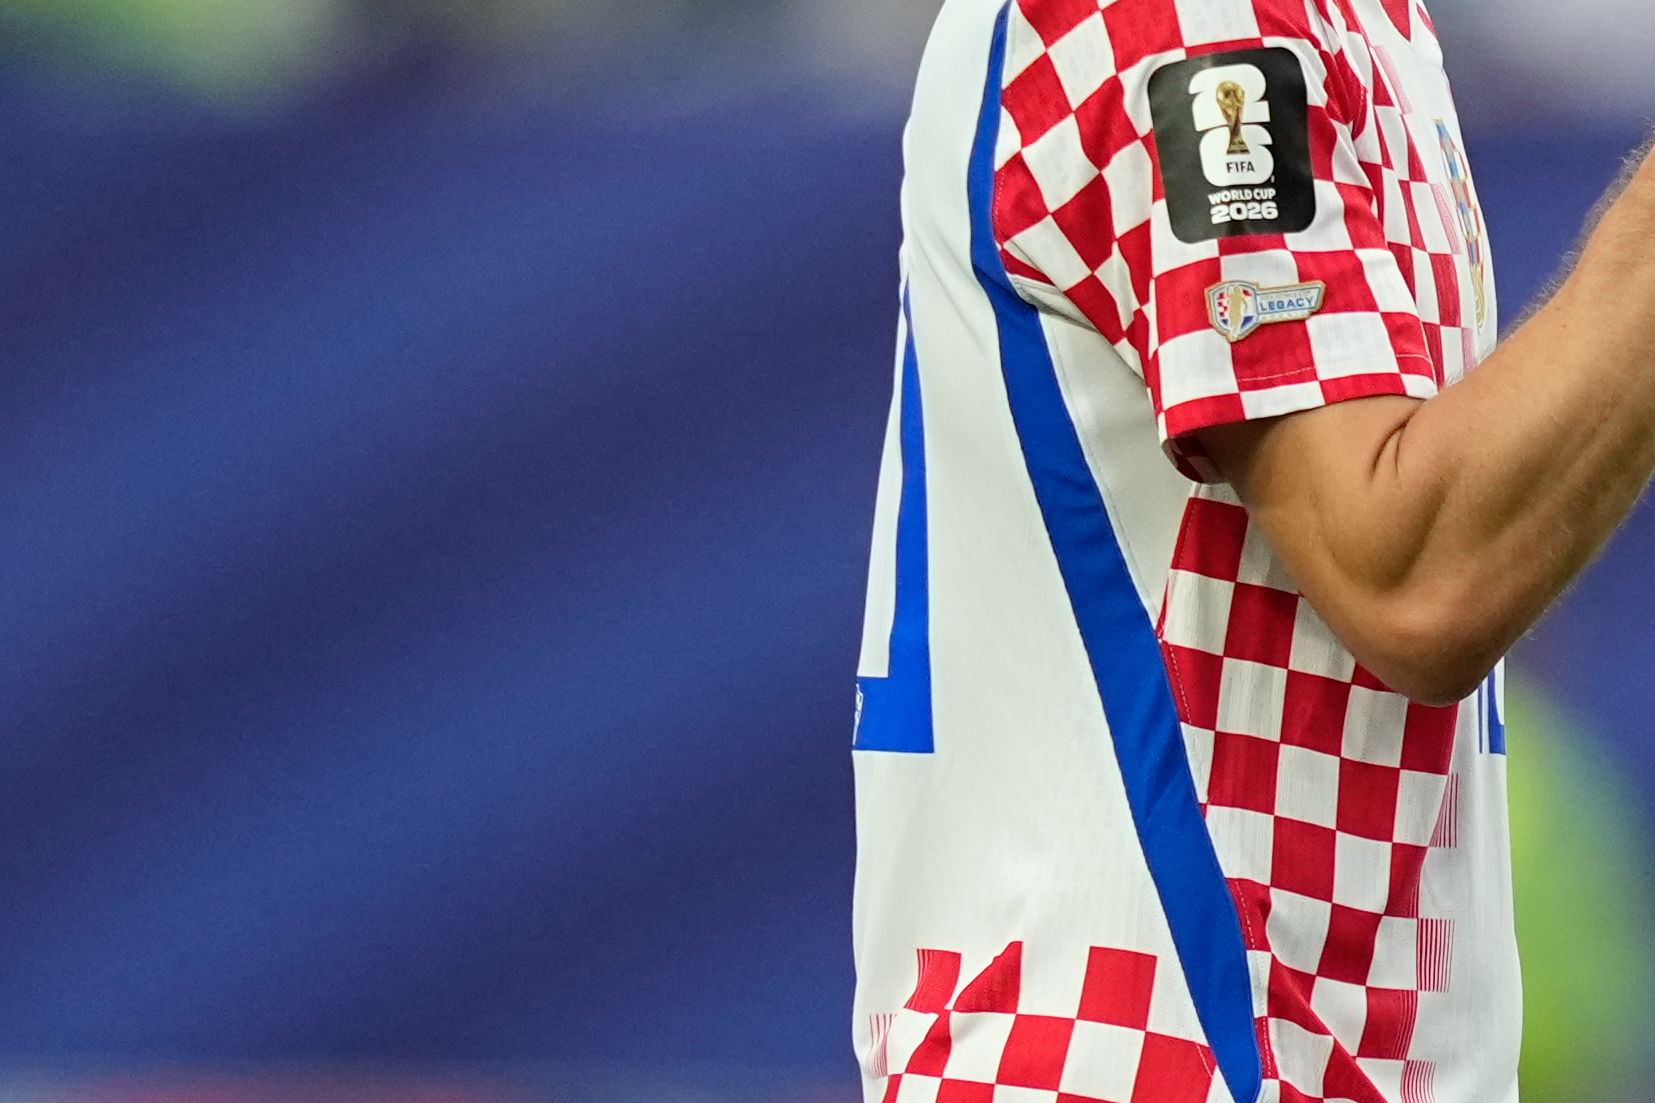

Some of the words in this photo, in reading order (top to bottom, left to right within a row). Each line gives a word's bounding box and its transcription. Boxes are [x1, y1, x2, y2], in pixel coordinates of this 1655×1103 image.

[1226, 161, 1255, 173] FIFA
[1207, 189, 1252, 205] WORLD
[1253, 187, 1276, 200] CUP
[1210, 201, 1279, 224] 2026
[1259, 296, 1314, 311] LEGACY
